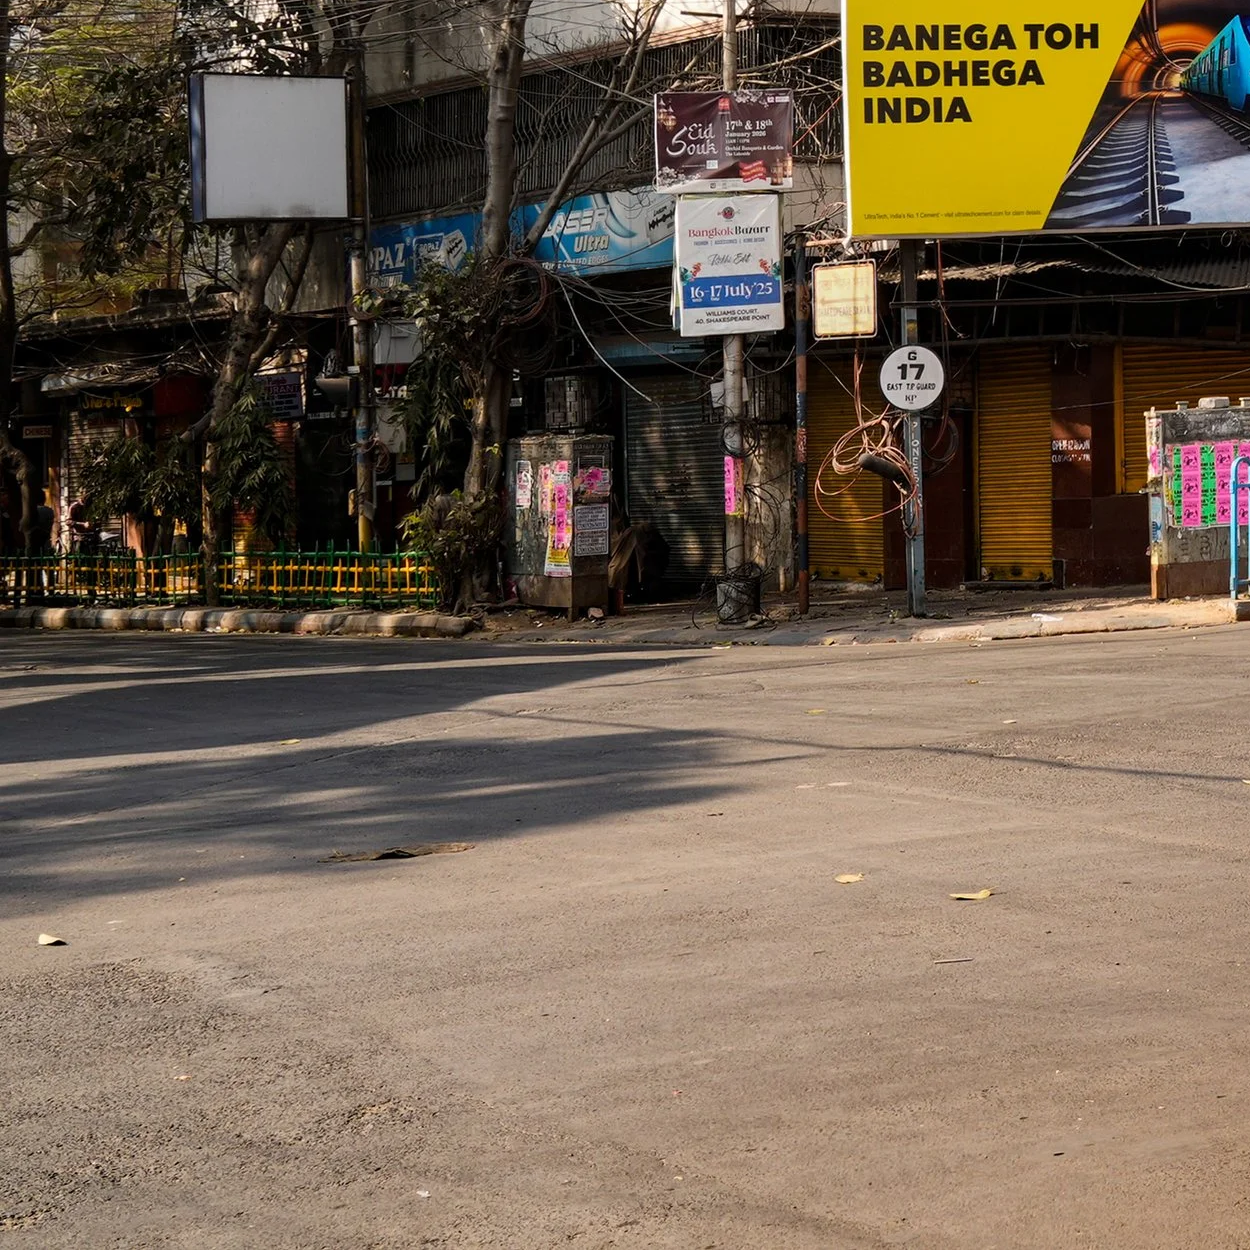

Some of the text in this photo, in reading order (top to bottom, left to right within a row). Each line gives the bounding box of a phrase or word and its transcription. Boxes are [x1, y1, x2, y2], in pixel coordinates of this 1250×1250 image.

[863, 23, 1099, 51] BANEGA TOH
[863, 59, 1045, 87] BADHEGA
[863, 97, 973, 124] INDIA
[688, 123, 715, 139] Eid
[666, 125, 719, 157] Souk
[688, 227, 734, 239] Bangkok
[574, 235, 610, 253] Ultra
[907, 351, 917, 361] G
[897, 363, 925, 380] 17
[886, 383, 902, 391] EAST
